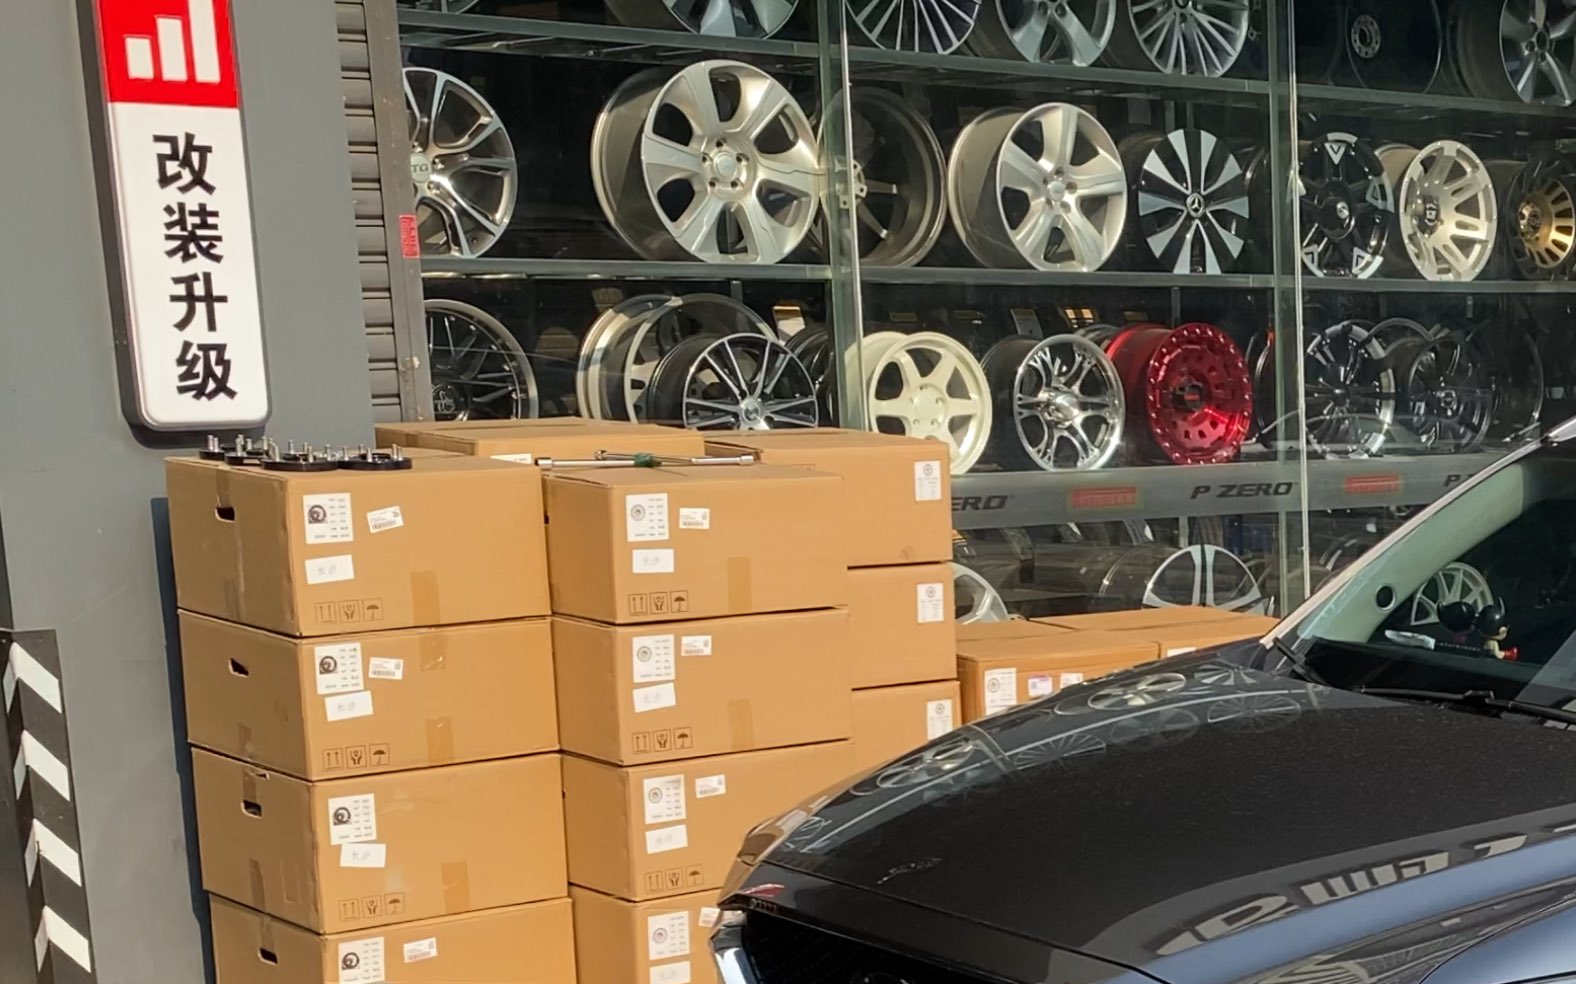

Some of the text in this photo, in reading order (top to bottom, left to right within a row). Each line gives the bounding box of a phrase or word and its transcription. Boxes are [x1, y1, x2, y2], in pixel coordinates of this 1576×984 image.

[153, 132, 238, 401] 改装升级
[1190, 482, 1294, 500] P ZERO
[952, 495, 1008, 511] ERO
